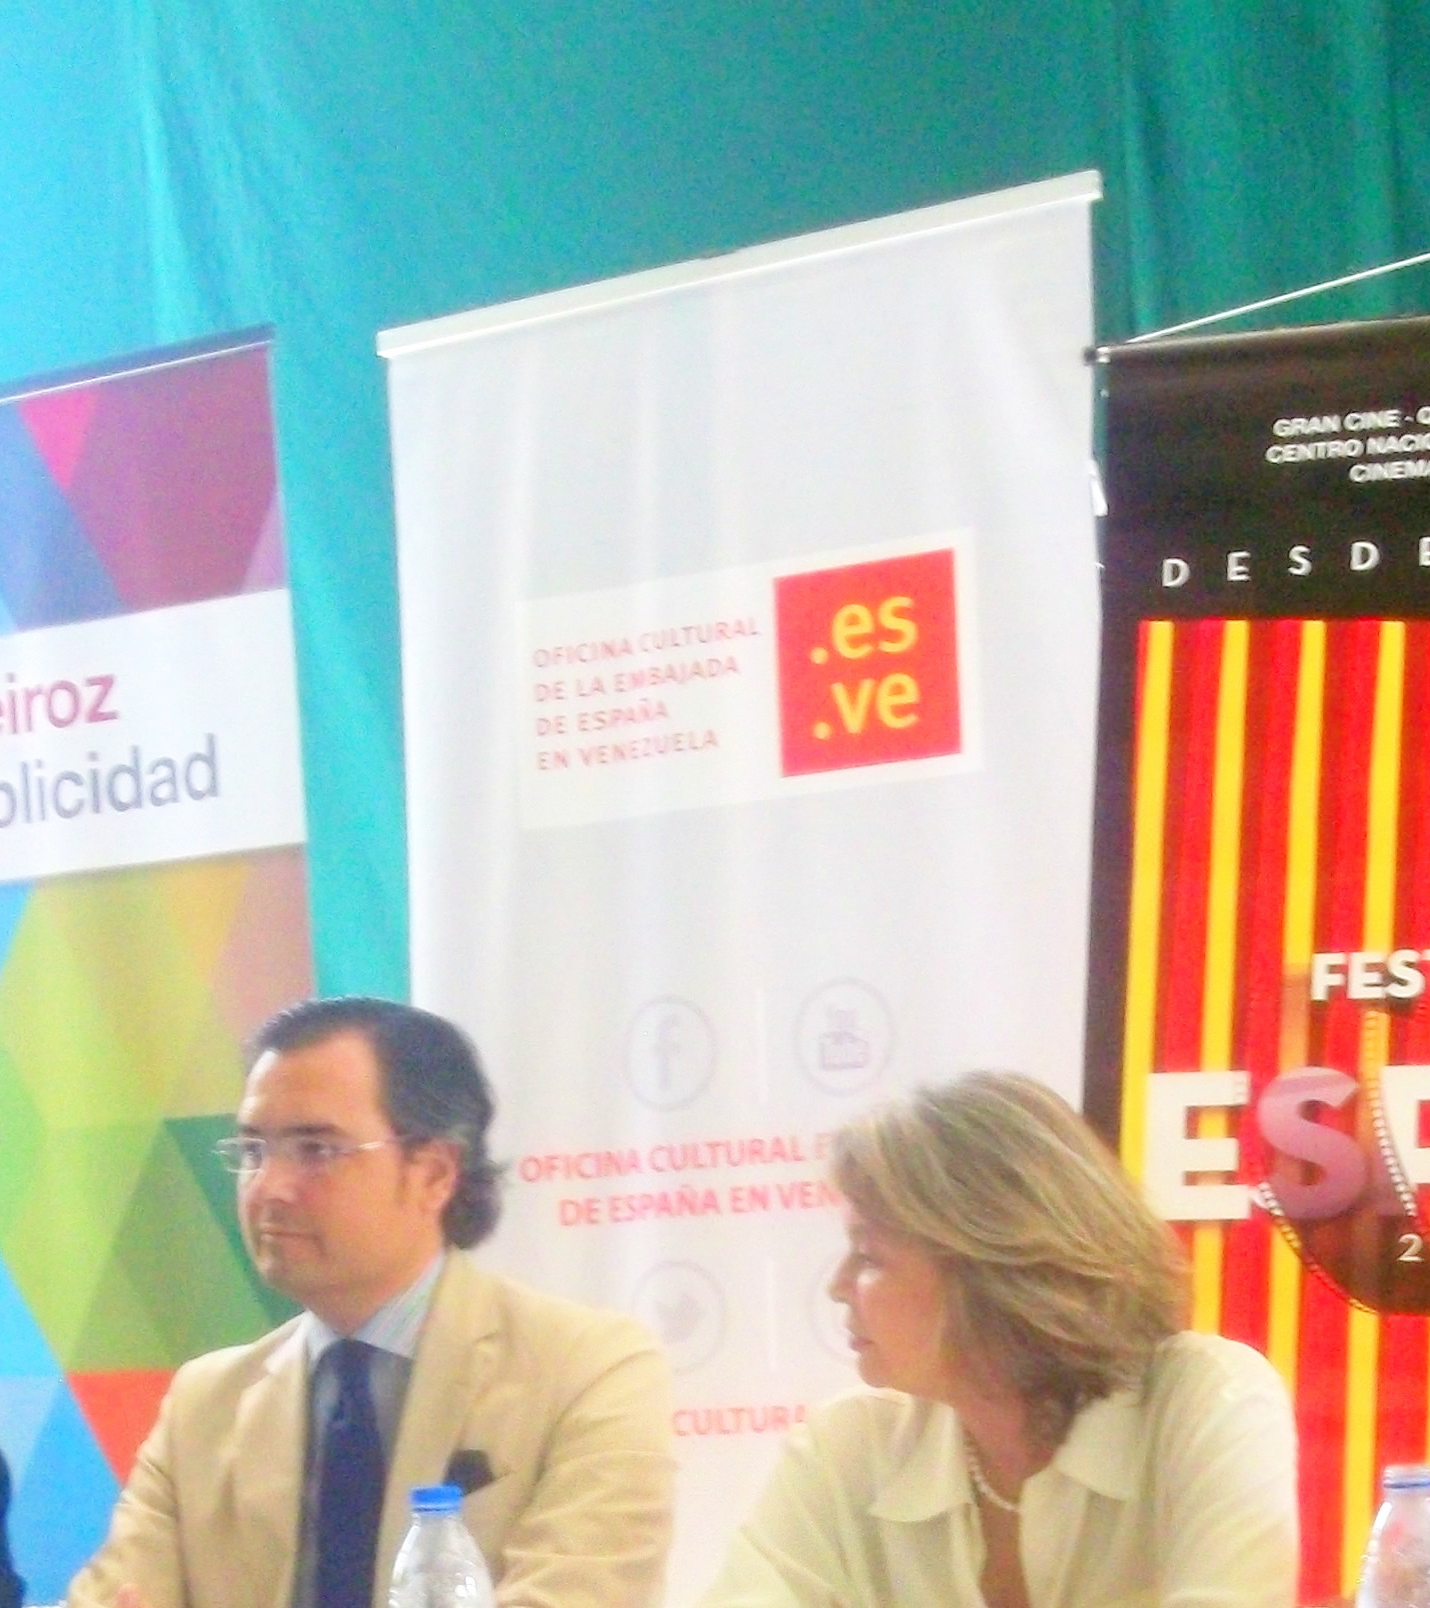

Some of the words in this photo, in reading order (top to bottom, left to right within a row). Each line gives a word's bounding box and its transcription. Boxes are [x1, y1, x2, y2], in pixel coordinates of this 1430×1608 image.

[1273, 416, 1340, 438] GRAN
[1343, 410, 1402, 431] CINE
[1266, 439, 1364, 464] CENTRO
[532, 636, 633, 669] OFICINA
[639, 615, 763, 654] CULTURAL
[809, 595, 919, 665] .es
[534, 680, 566, 703] DE
[575, 674, 606, 698] LA
[613, 654, 741, 694] EMBAJADA
[534, 716, 567, 737] DE
[576, 698, 669, 734] ESPAÑA
[812, 670, 921, 740] .ve
[538, 749, 570, 771] EN
[578, 727, 719, 767] VENEZUELA
[519, 1149, 640, 1184] OFICINA
[649, 1136, 806, 1174] CULTURAL
[558, 1198, 600, 1228] DE
[608, 1184, 720, 1225] ESPAÑA
[730, 1186, 771, 1214] EN
